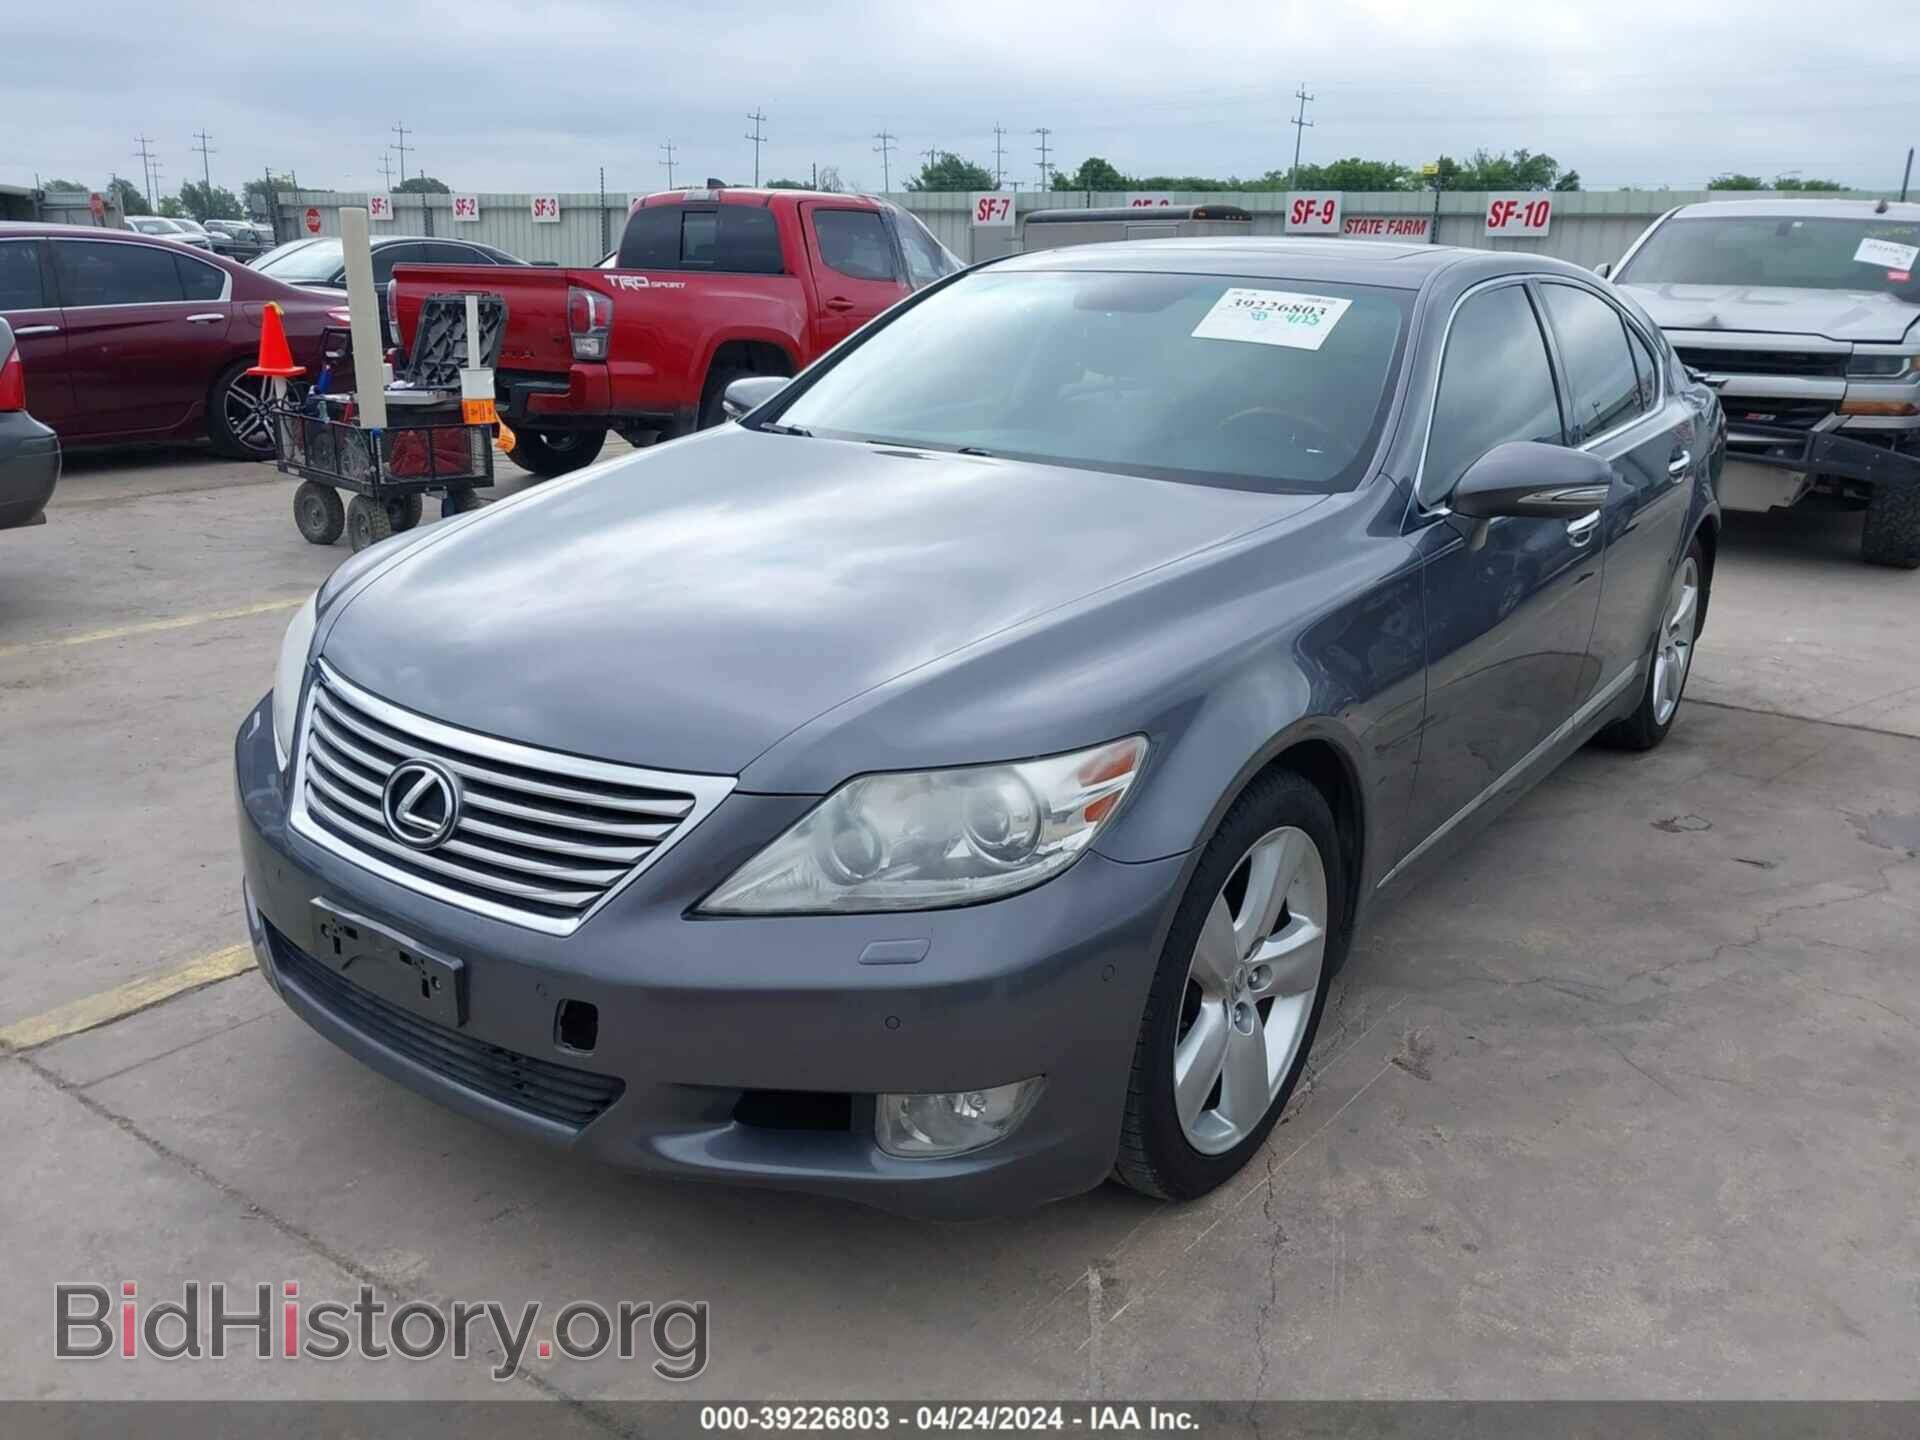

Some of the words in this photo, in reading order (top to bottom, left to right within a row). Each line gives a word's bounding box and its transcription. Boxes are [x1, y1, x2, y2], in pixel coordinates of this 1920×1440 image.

[371, 198, 389, 215] SF-1
[455, 198, 475, 216] SF-2
[534, 199, 556, 217] SF-3
[977, 198, 1010, 221] SF-7
[1291, 199, 1335, 225] SF-9
[1487, 200, 1550, 228] SF-10
[1344, 218, 1385, 235] STATE
[1386, 219, 1427, 236] FARM
[603, 274, 650, 291] TRD
[651, 281, 686, 289] SPORT
